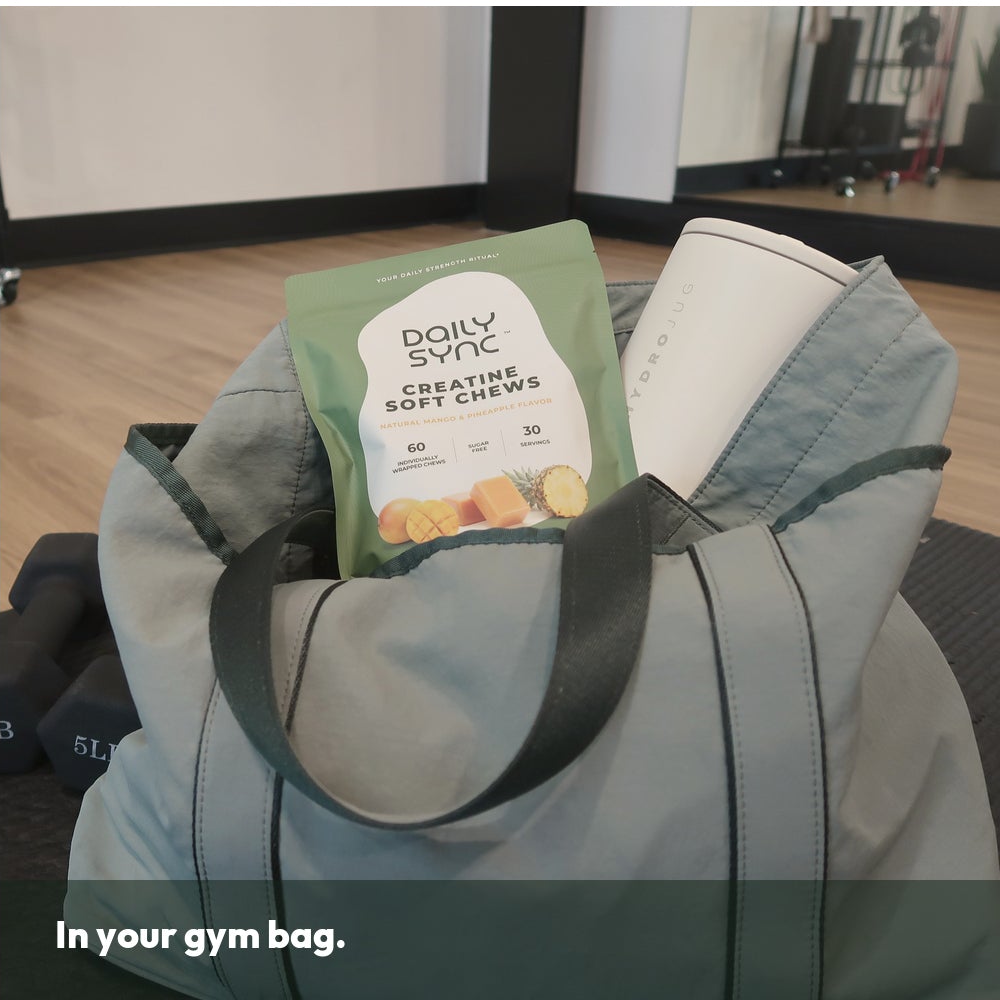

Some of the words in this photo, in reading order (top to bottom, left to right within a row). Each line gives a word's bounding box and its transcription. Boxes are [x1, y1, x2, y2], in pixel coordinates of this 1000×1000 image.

[377, 274, 398, 283] YOUR
[400, 268, 423, 278] DAILY
[425, 258, 466, 272] STRENGTH
[401, 311, 496, 347] DAILY
[408, 334, 500, 368] SYNC
[402, 366, 518, 396] CREATINE
[385, 395, 445, 412] SOFT
[455, 376, 541, 405] CHEWS
[379, 420, 421, 430] NATURAL
[423, 415, 456, 424] MANGO
[467, 404, 516, 419] PINEAPPLE
[518, 398, 552, 408] FLAVOR
[523, 424, 541, 436] 30
[407, 442, 426, 453] 60
[468, 440, 489, 449] SUGAR
[520, 439, 551, 447] SERVINGS
[392, 463, 422, 474] WRAPPED
[424, 459, 446, 468] CHEWS
[397, 455, 439, 467] INDIVIDUALLY
